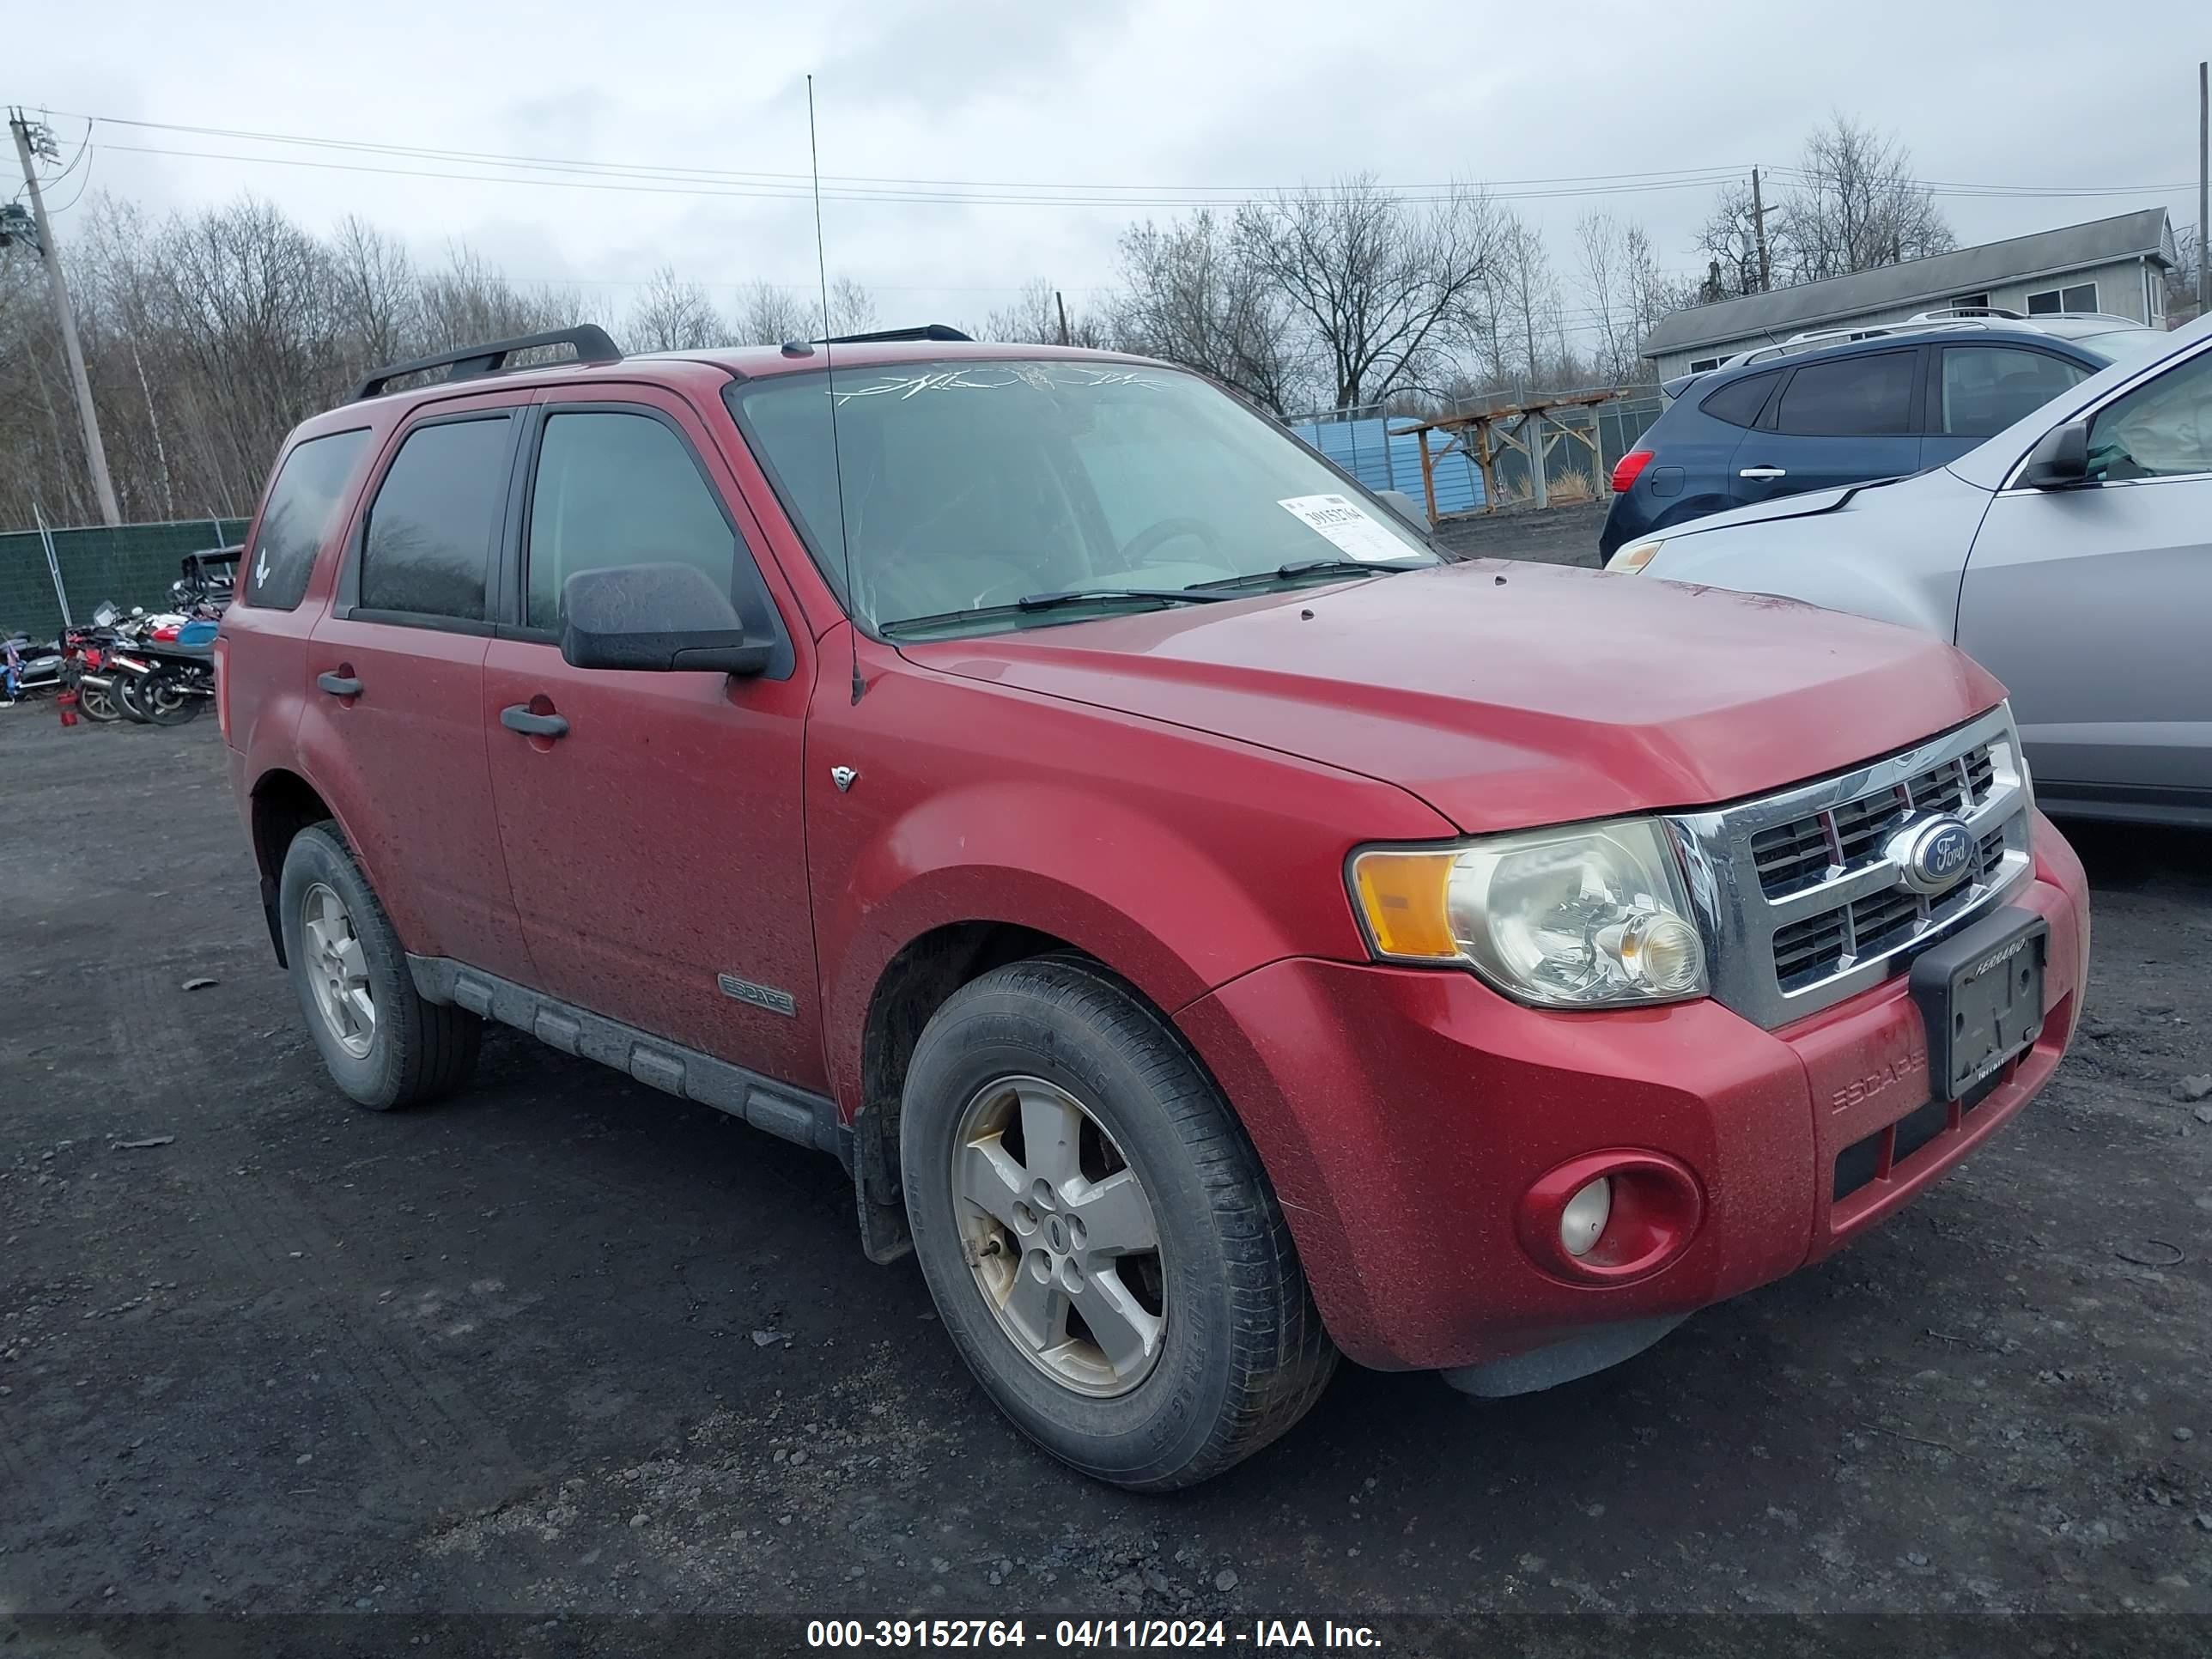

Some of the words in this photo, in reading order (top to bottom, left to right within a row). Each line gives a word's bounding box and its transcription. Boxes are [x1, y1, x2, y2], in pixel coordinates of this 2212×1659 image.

[1304, 507, 1365, 526] 39152764
[1936, 833, 1966, 872] Ford
[721, 977, 792, 1011] ESCAPE
[1832, 1048, 1925, 1115] ESCAPE
